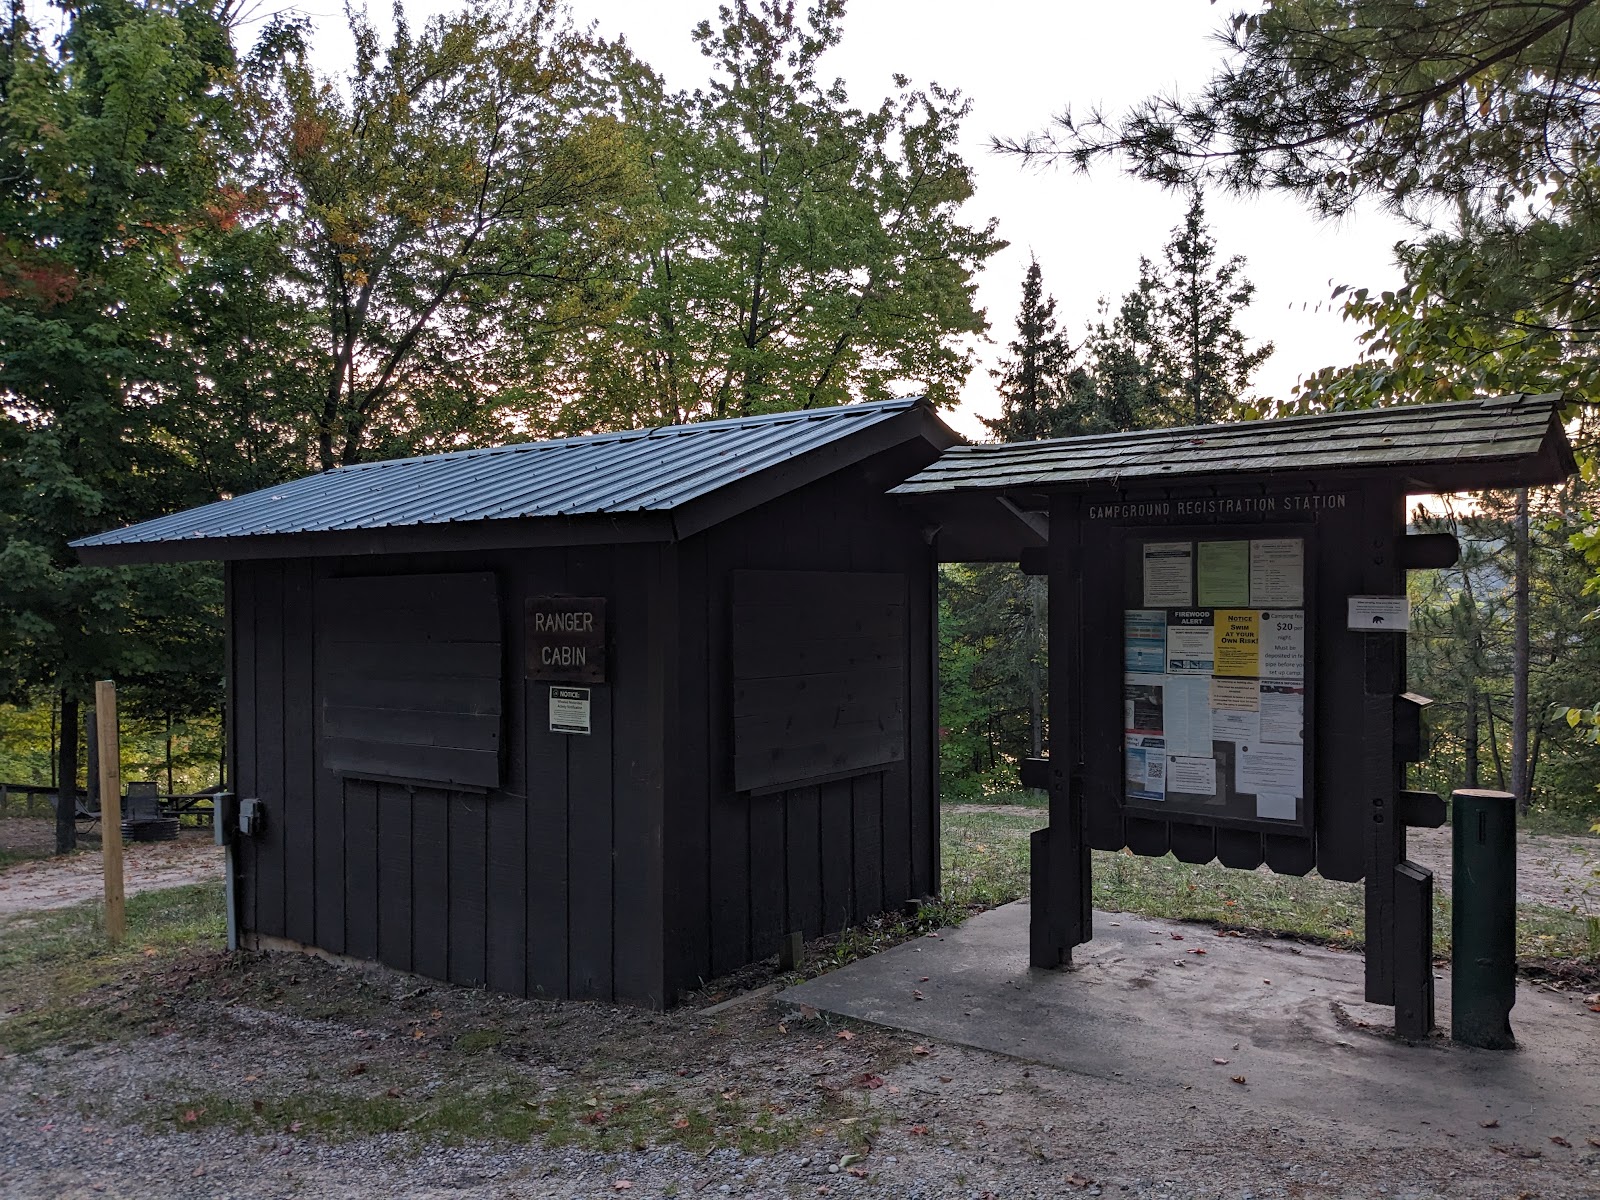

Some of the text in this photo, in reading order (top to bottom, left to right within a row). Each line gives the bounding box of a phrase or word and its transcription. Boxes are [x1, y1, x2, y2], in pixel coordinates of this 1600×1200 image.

[1089, 494, 1347, 519] CAMPGROUND REGISTRATION STATION
[535, 612, 593, 632] RANGER
[1276, 622, 1292, 631] $20
[541, 646, 586, 666] CABIN
